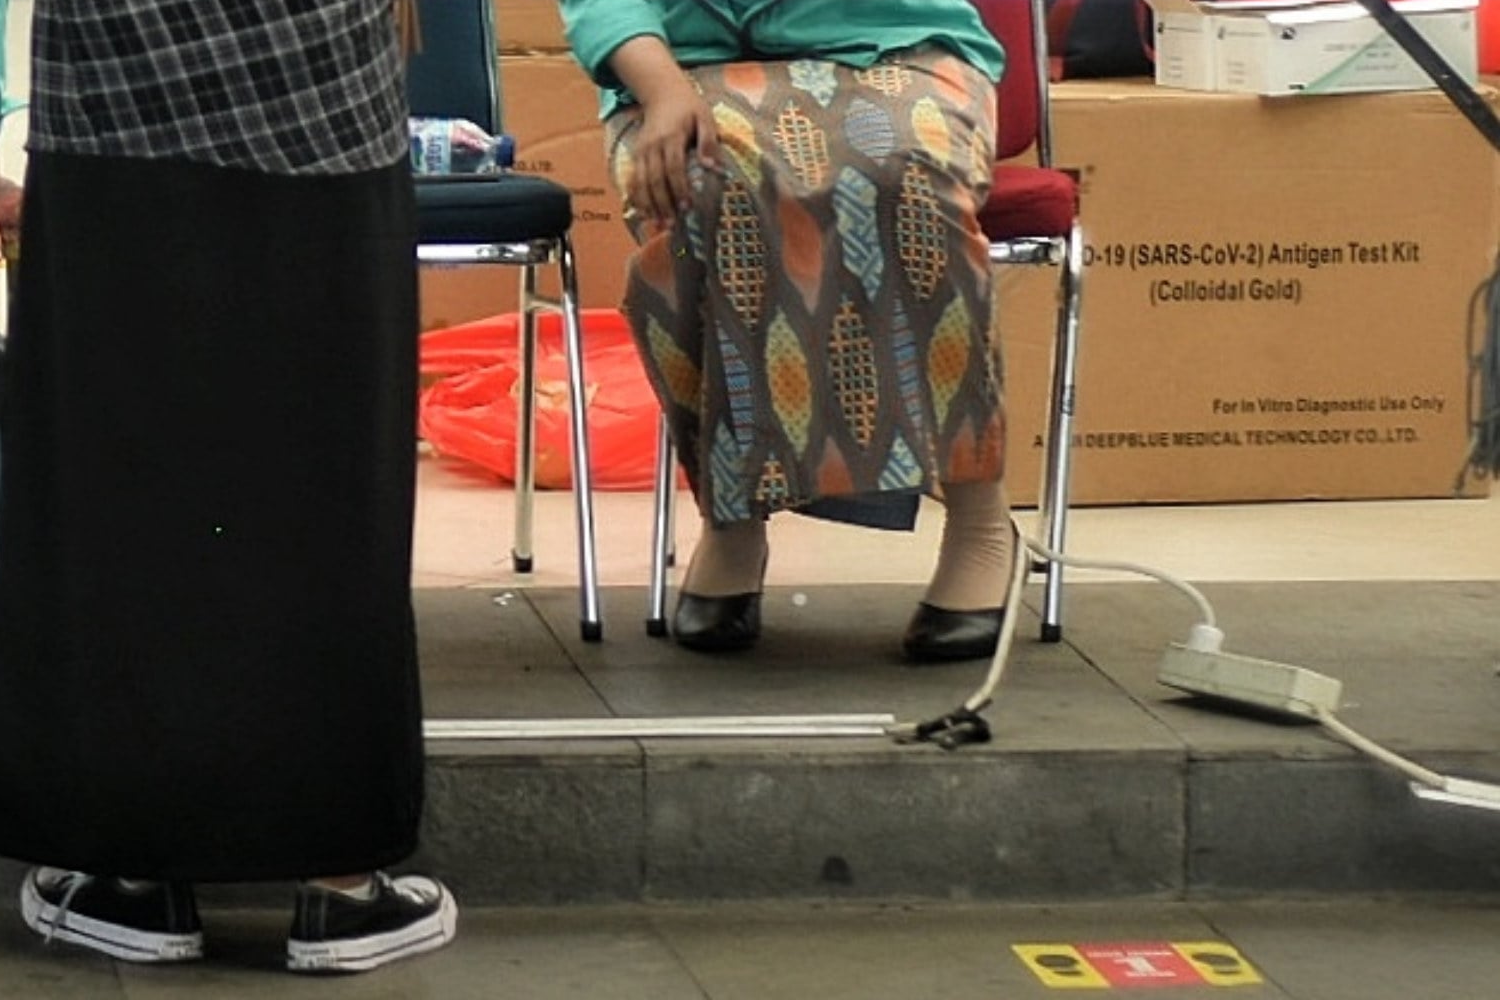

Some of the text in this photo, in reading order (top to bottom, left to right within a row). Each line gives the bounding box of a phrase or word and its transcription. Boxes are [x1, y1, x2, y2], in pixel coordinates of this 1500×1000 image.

[1129, 242, 1264, 271] (SARS-CoV-2)
[1267, 242, 1343, 270] Antigen
[1347, 242, 1389, 264] Test
[1392, 240, 1420, 263] Kit
[1149, 278, 1302, 307] (Colloidal Gold)
[1212, 394, 1445, 416] For In Vitro Diagnostic Use Only
[1085, 432, 1170, 448] DEEPBLUE
[1172, 430, 1242, 447] MEDICAL
[1246, 428, 1350, 446] TECHNOLOGY
